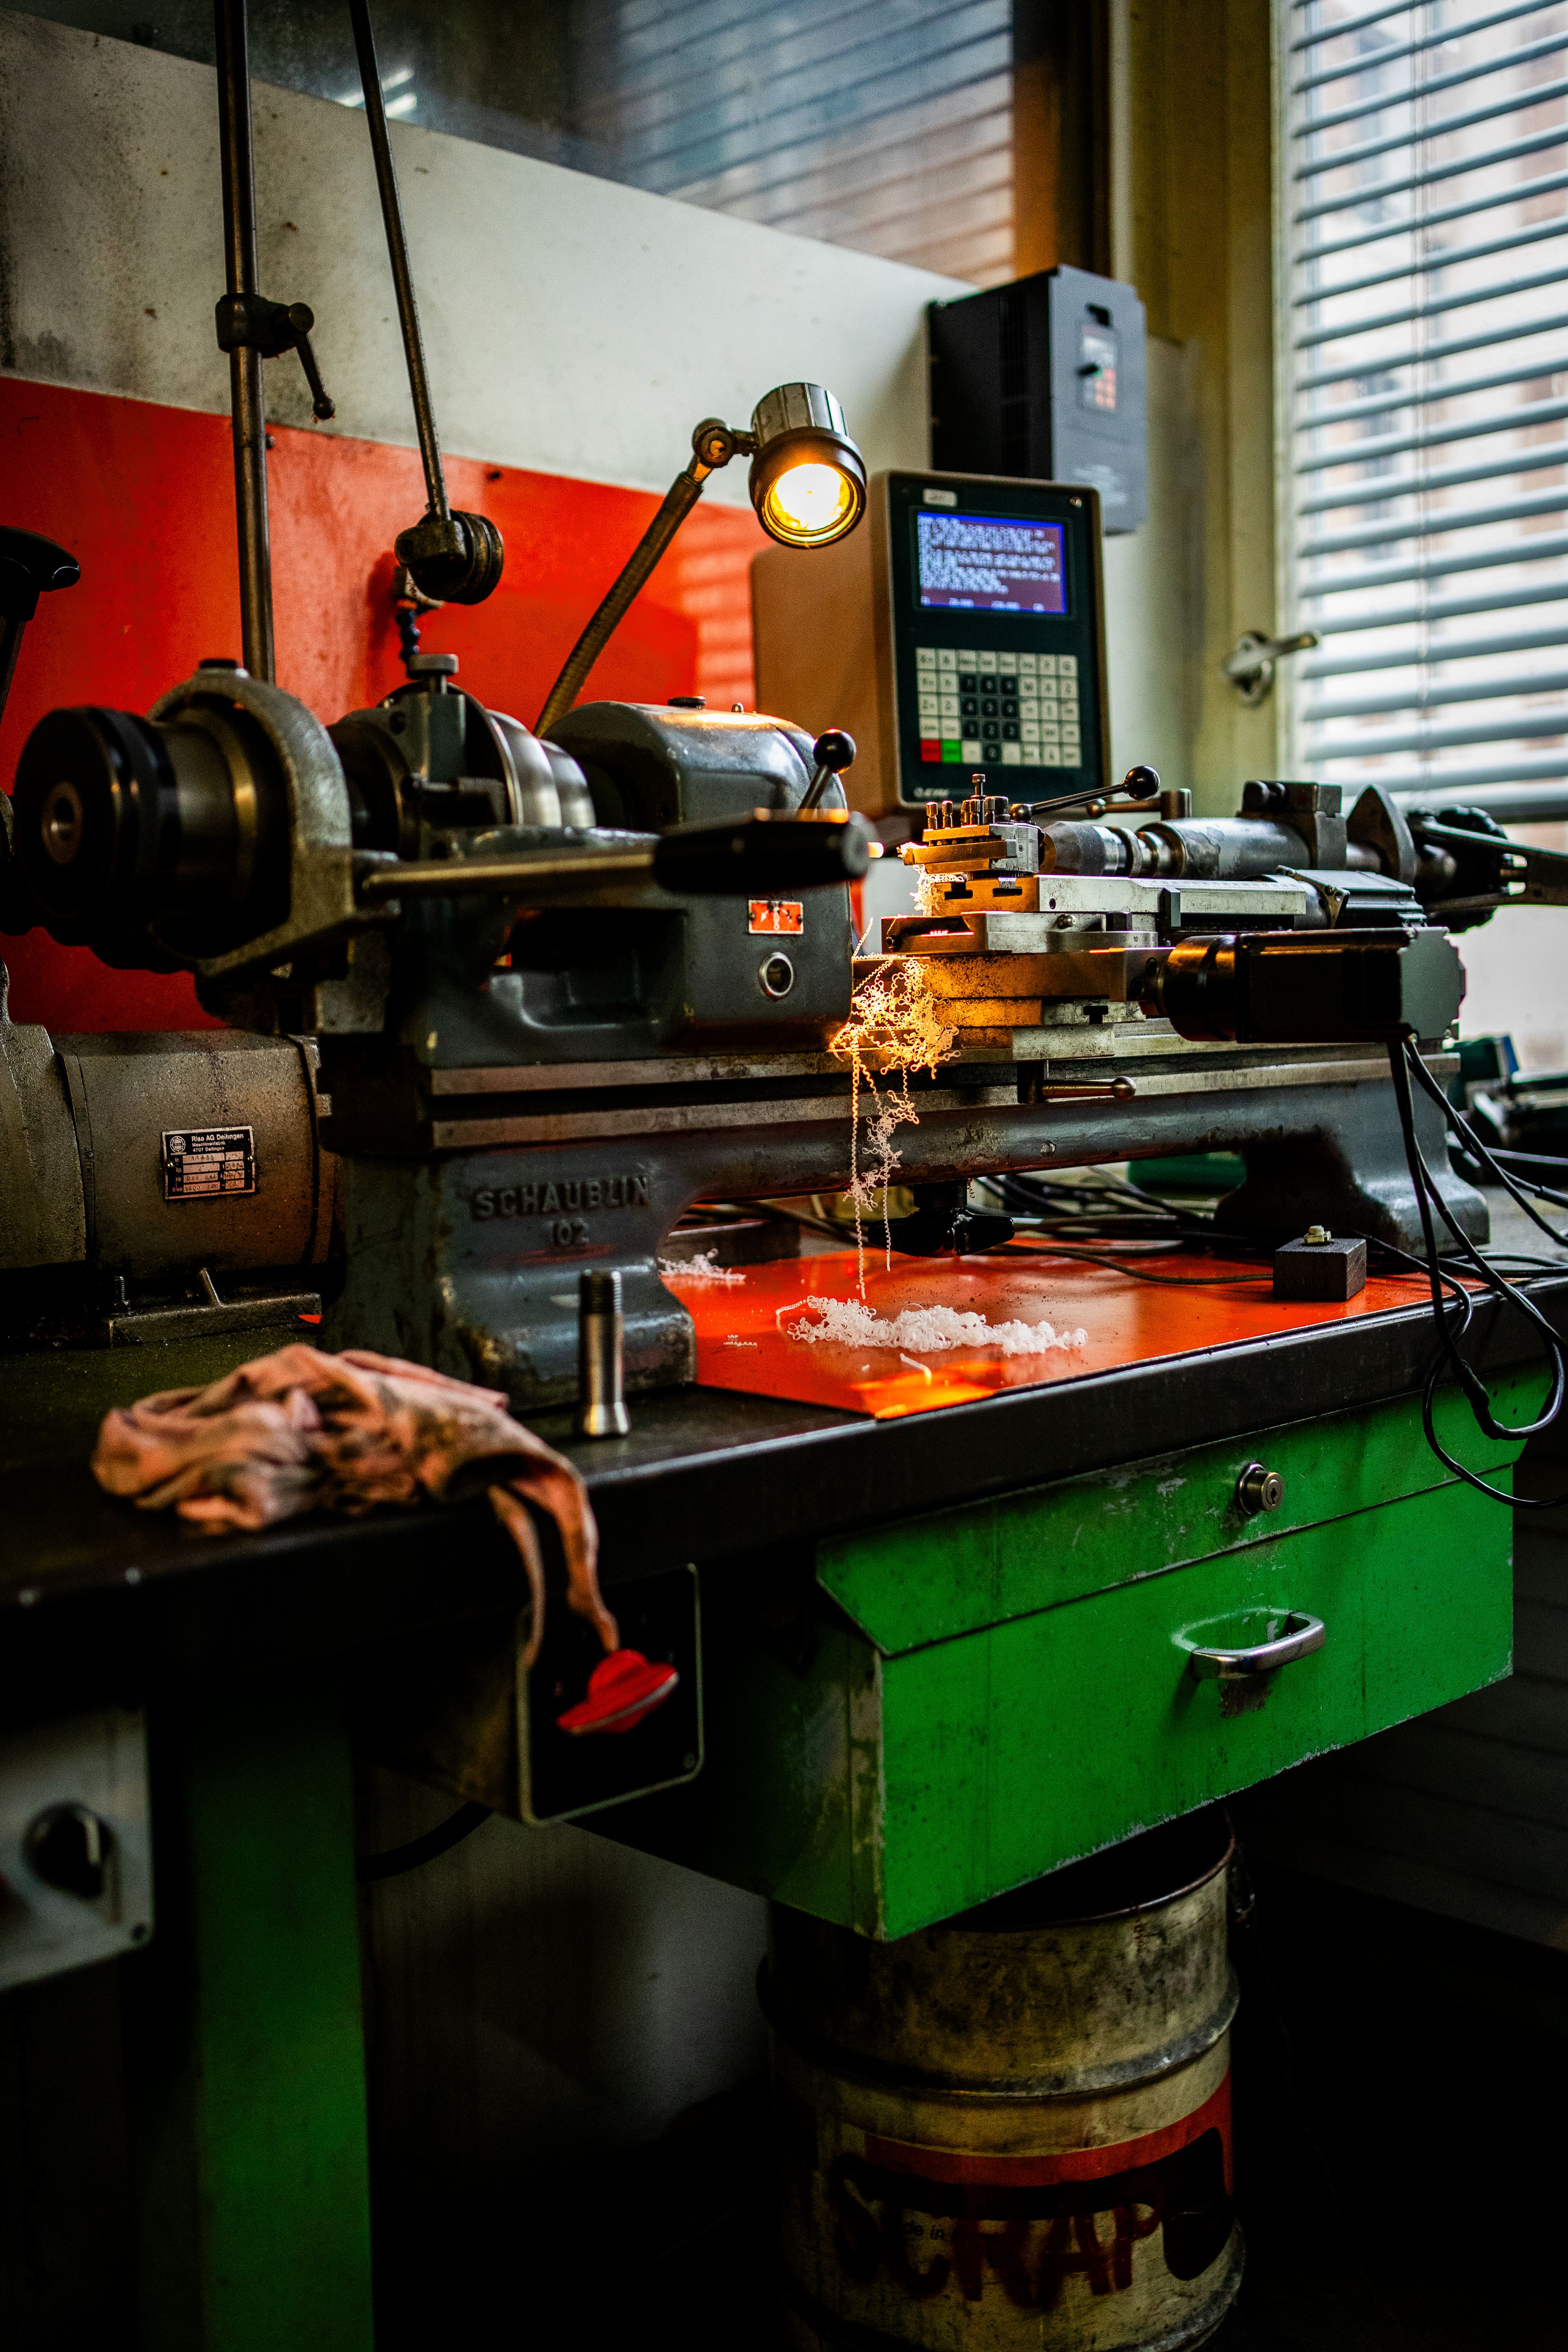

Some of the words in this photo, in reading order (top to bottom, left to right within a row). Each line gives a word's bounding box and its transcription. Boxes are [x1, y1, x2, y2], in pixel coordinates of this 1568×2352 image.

[474, 1175, 648, 1219] SCHAUBLIN
[833, 2153, 1168, 2312] SCRAP
[901, 2221, 924, 2236] de
[931, 2225, 944, 2240] in
